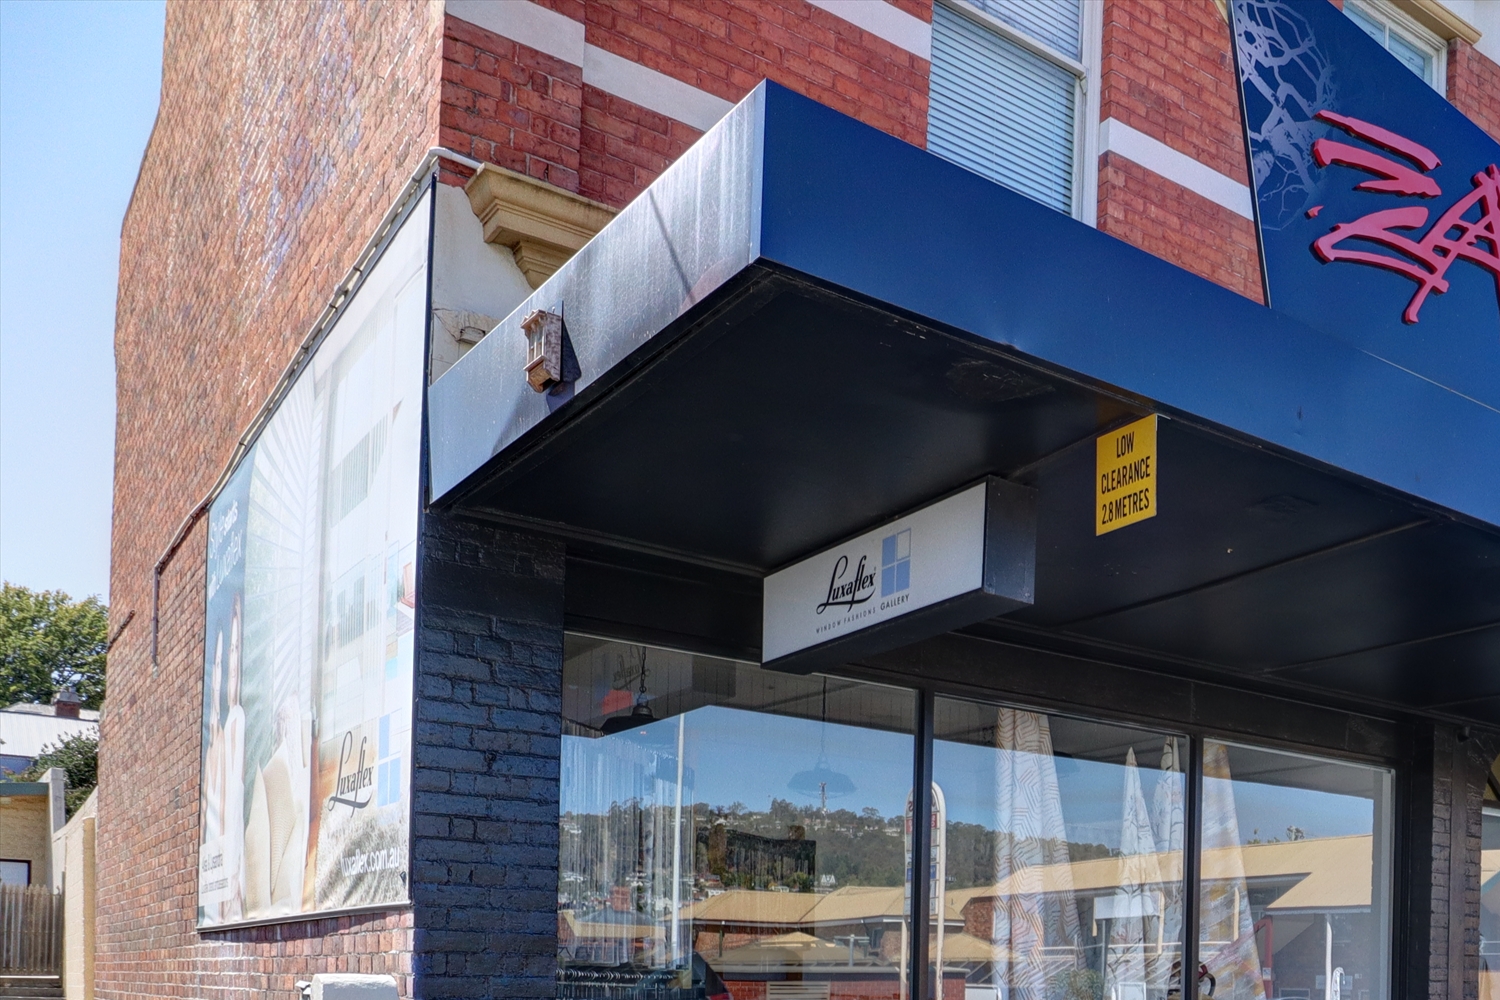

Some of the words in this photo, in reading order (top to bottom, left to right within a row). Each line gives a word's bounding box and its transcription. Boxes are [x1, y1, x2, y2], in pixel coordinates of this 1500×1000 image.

[1116, 431, 1135, 458] LOW
[1101, 456, 1151, 495] CLEARANCE
[1102, 501, 1114, 525] 2.8
[1115, 488, 1150, 520] METRES
[816, 555, 876, 614] Luxaflex
[816, 620, 841, 634] WINDOW
[844, 607, 876, 624] FASHIONS
[880, 594, 910, 611] GALLERY
[328, 730, 375, 818] Luxaflex
[340, 846, 400, 877] luxaflex.com.au
